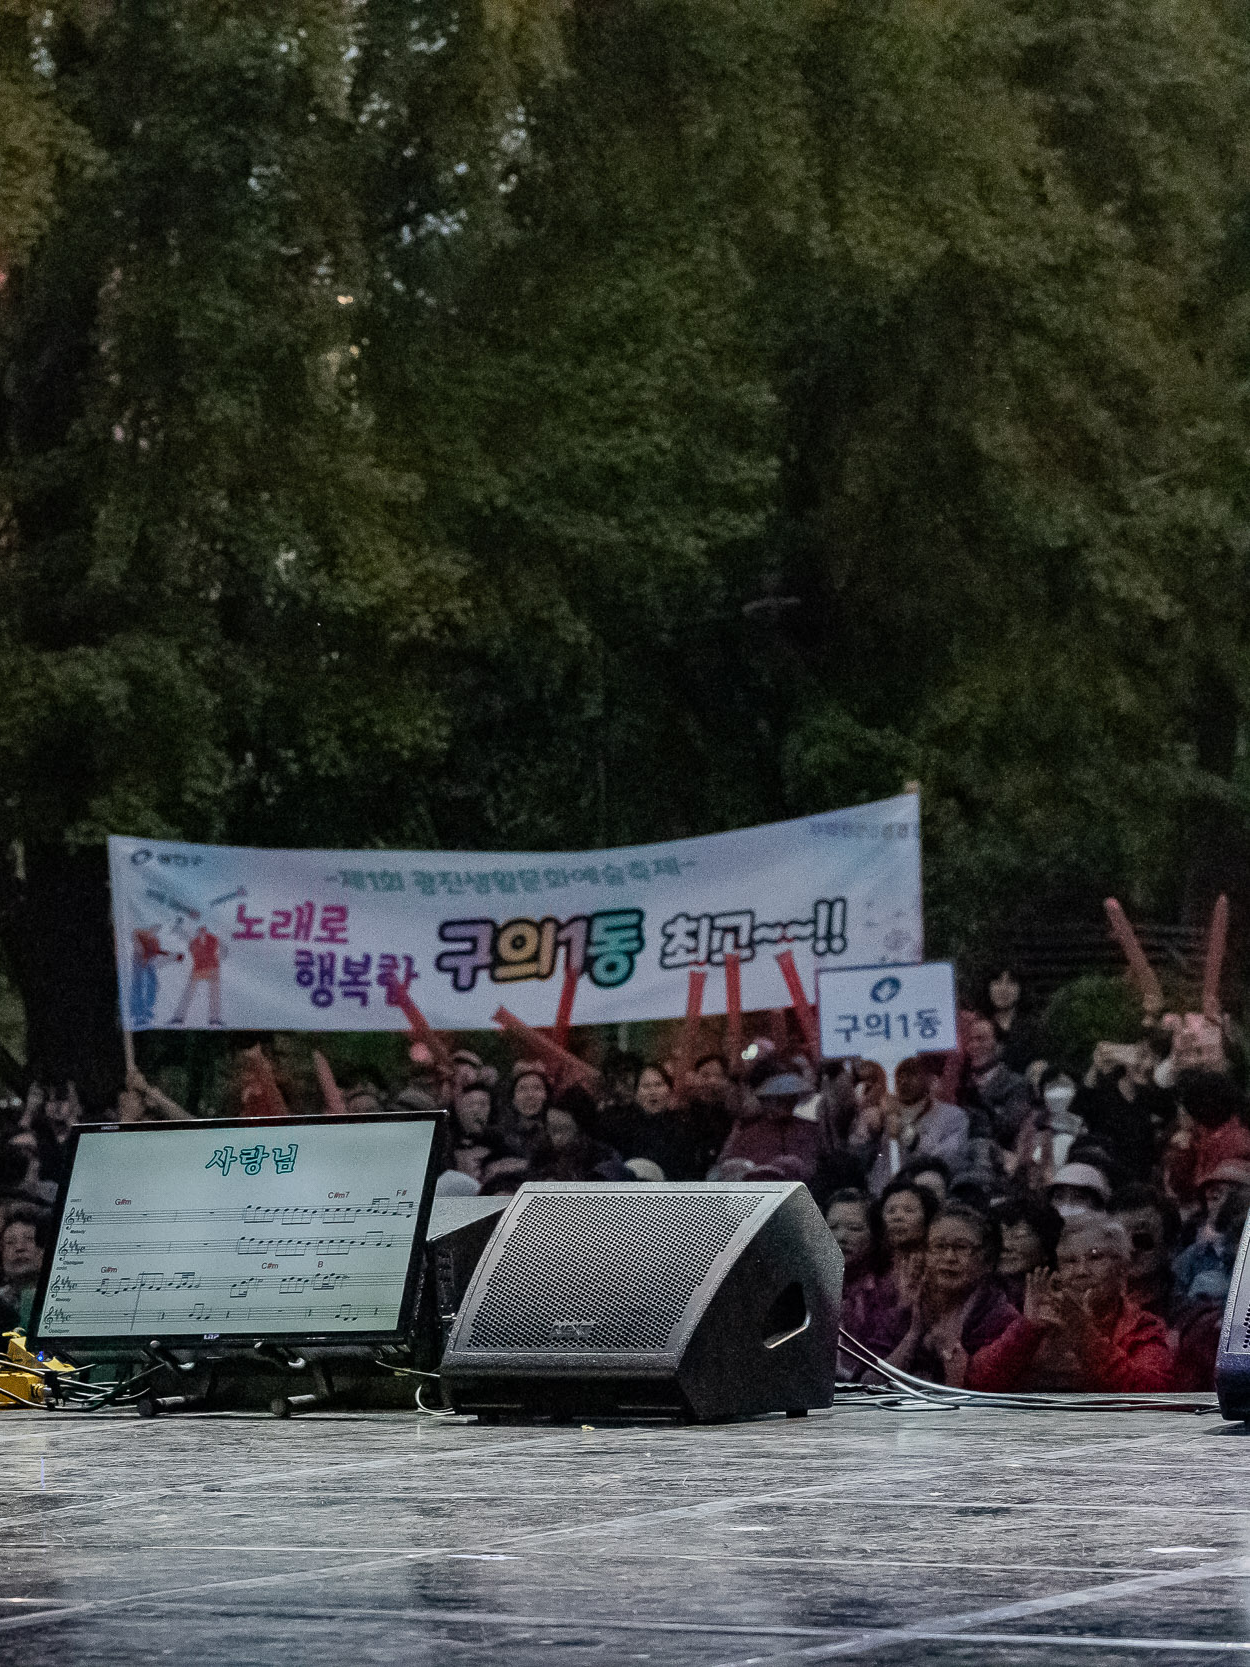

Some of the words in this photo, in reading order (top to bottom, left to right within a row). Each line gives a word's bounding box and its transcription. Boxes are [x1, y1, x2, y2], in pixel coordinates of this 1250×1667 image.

[232, 900, 350, 944] 노래로
[435, 908, 645, 992] 구의1동
[834, 1008, 941, 1042] 구의1동
[205, 1143, 299, 1176] 사랑님
[317, 1260, 324, 1268] B
